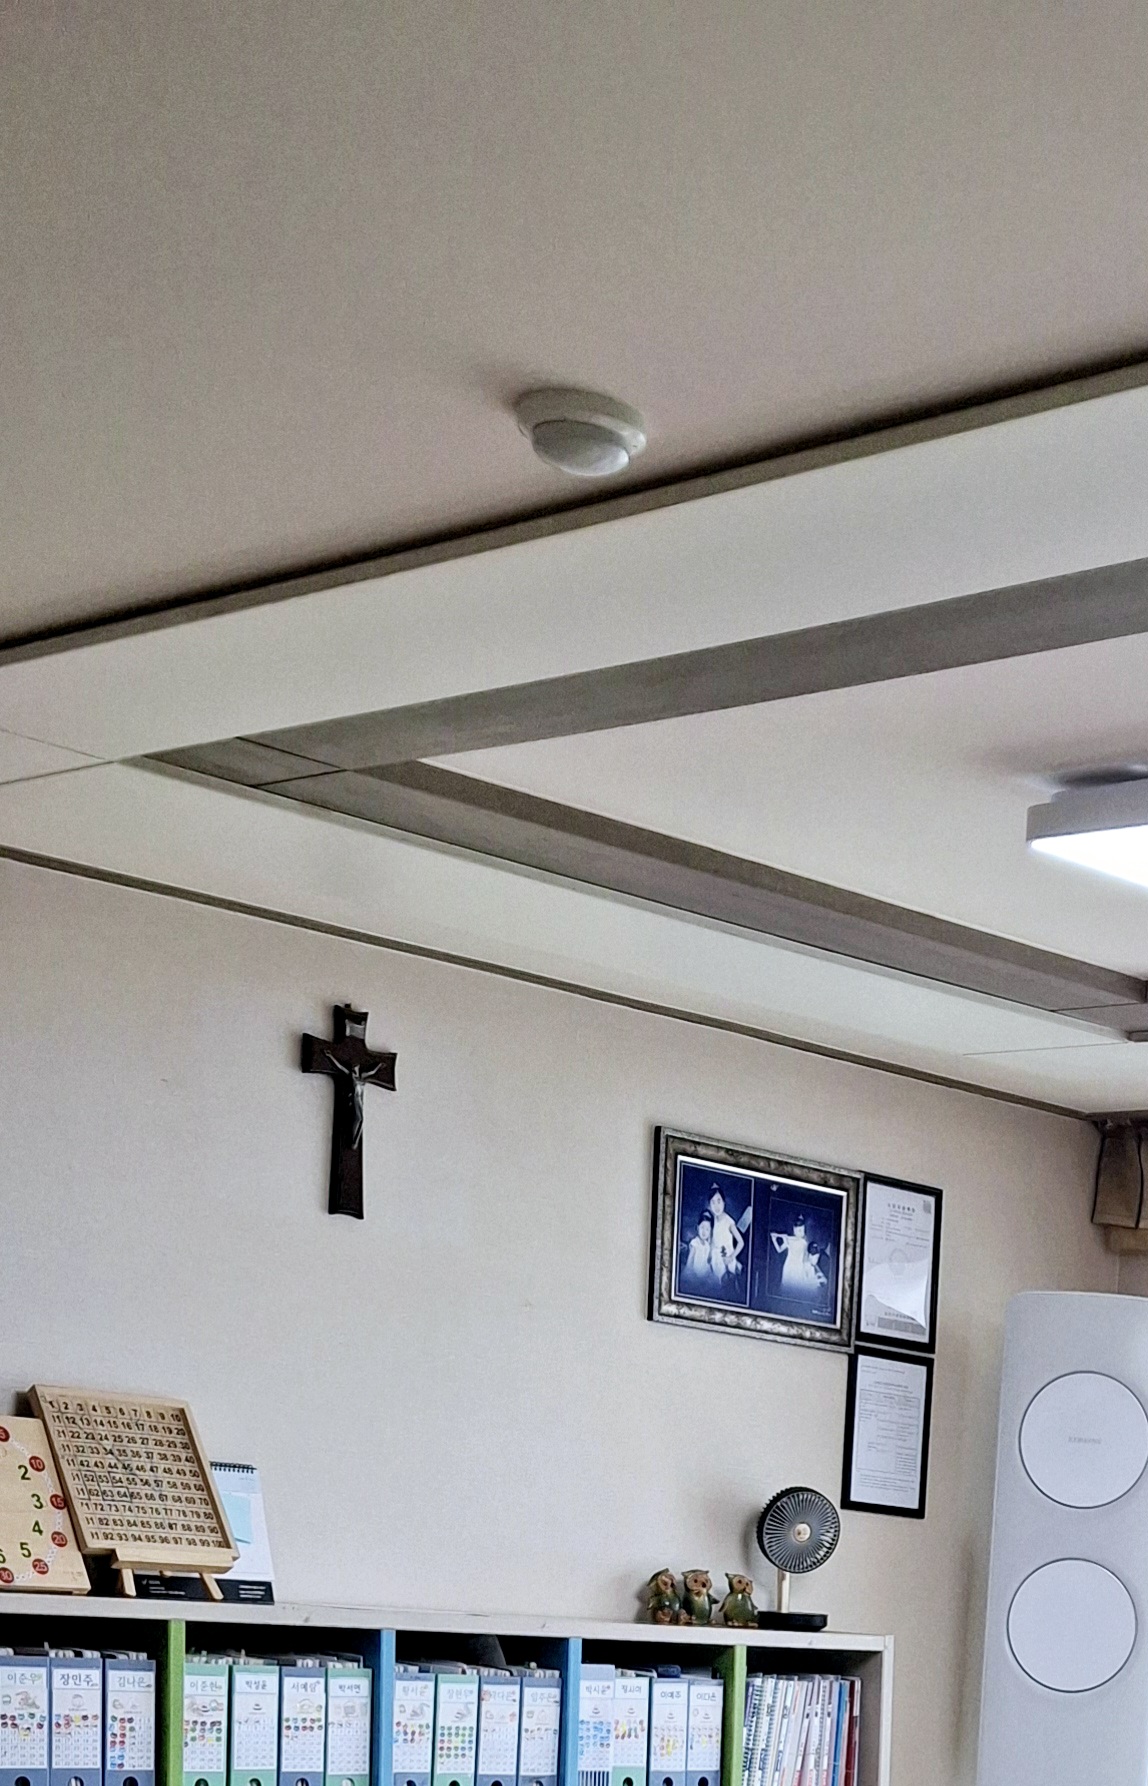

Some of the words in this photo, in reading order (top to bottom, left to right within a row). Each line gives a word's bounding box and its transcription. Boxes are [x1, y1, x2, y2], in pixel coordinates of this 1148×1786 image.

[63, 1401, 69, 1410] 2
[92, 1404, 97, 1412] 4
[104, 1406, 111, 1414] 5
[131, 1409, 138, 1417] 7
[52, 1415, 61, 1424] 11
[65, 1416, 76, 1424] 12
[80, 1417, 91, 1426] 13
[94, 1419, 104, 1427] 14
[107, 1420, 118, 1429] 15
[121, 1421, 132, 1430] 16
[135, 1422, 144, 1431] 17
[149, 1425, 159, 1433] 18
[162, 1426, 172, 1434] 19
[69, 1430, 81, 1439] 22
[98, 1433, 109, 1441] 24
[112, 1434, 123, 1443] 25
[125, 1436, 137, 1444] 26
[139, 1437, 149, 1445] 27
[166, 1440, 177, 1448] 29
[74, 1445, 86, 1453] 32
[88, 1446, 100, 1455] 33
[116, 1449, 128, 1457] 35
[130, 1449, 142, 1458] 36
[144, 1451, 154, 1459] 37
[185, 1455, 195, 1464] 40
[30, 1459, 43, 1469] 10
[80, 1460, 91, 1468] 42
[94, 1460, 104, 1469] 43
[108, 1461, 119, 1470] 44
[149, 1465, 158, 1473] 47
[176, 1468, 187, 1476] 49
[18, 1465, 31, 1480] 2
[84, 1474, 95, 1482] 52
[98, 1475, 109, 1484] 53
[112, 1476, 123, 1484] 54
[126, 1477, 138, 1486] 55
[154, 1480, 163, 1488] 57
[167, 1481, 178, 1489] 58
[181, 1482, 191, 1490] 59
[31, 1494, 44, 1510] 3
[52, 1497, 64, 1507] 15
[89, 1489, 100, 1497] 62
[144, 1493, 156, 1501] 66
[159, 1494, 168, 1502] 67
[185, 1496, 196, 1505] 69
[198, 1498, 209, 1506] 70
[93, 1503, 105, 1511] 72
[107, 1504, 119, 1512] 73
[121, 1505, 133, 1513] 74
[135, 1506, 147, 1514] 75
[149, 1507, 161, 1515] 76
[163, 1508, 173, 1516] 77
[176, 1509, 187, 1517] 78
[189, 1510, 201, 1519] 79
[32, 1520, 43, 1536] 4
[98, 1517, 110, 1526] 82
[112, 1519, 124, 1527] 83
[126, 1519, 138, 1527] 84
[140, 1520, 152, 1529] 85
[154, 1521, 165, 1530] 86
[181, 1523, 192, 1532] 88
[194, 1525, 206, 1533] 89
[53, 1534, 66, 1545] 20
[103, 1532, 115, 1540] 92
[117, 1533, 129, 1541] 93
[131, 1534, 143, 1542] 94
[145, 1535, 156, 1543] 95
[159, 1535, 170, 1544] 96
[172, 1537, 183, 1545] 97
[185, 1538, 197, 1546] 98
[199, 1539, 210, 1547] 99
[19, 1542, 31, 1558] 5
[34, 1561, 47, 1571] 25
[60, 1672, 93, 1686] 장민주
